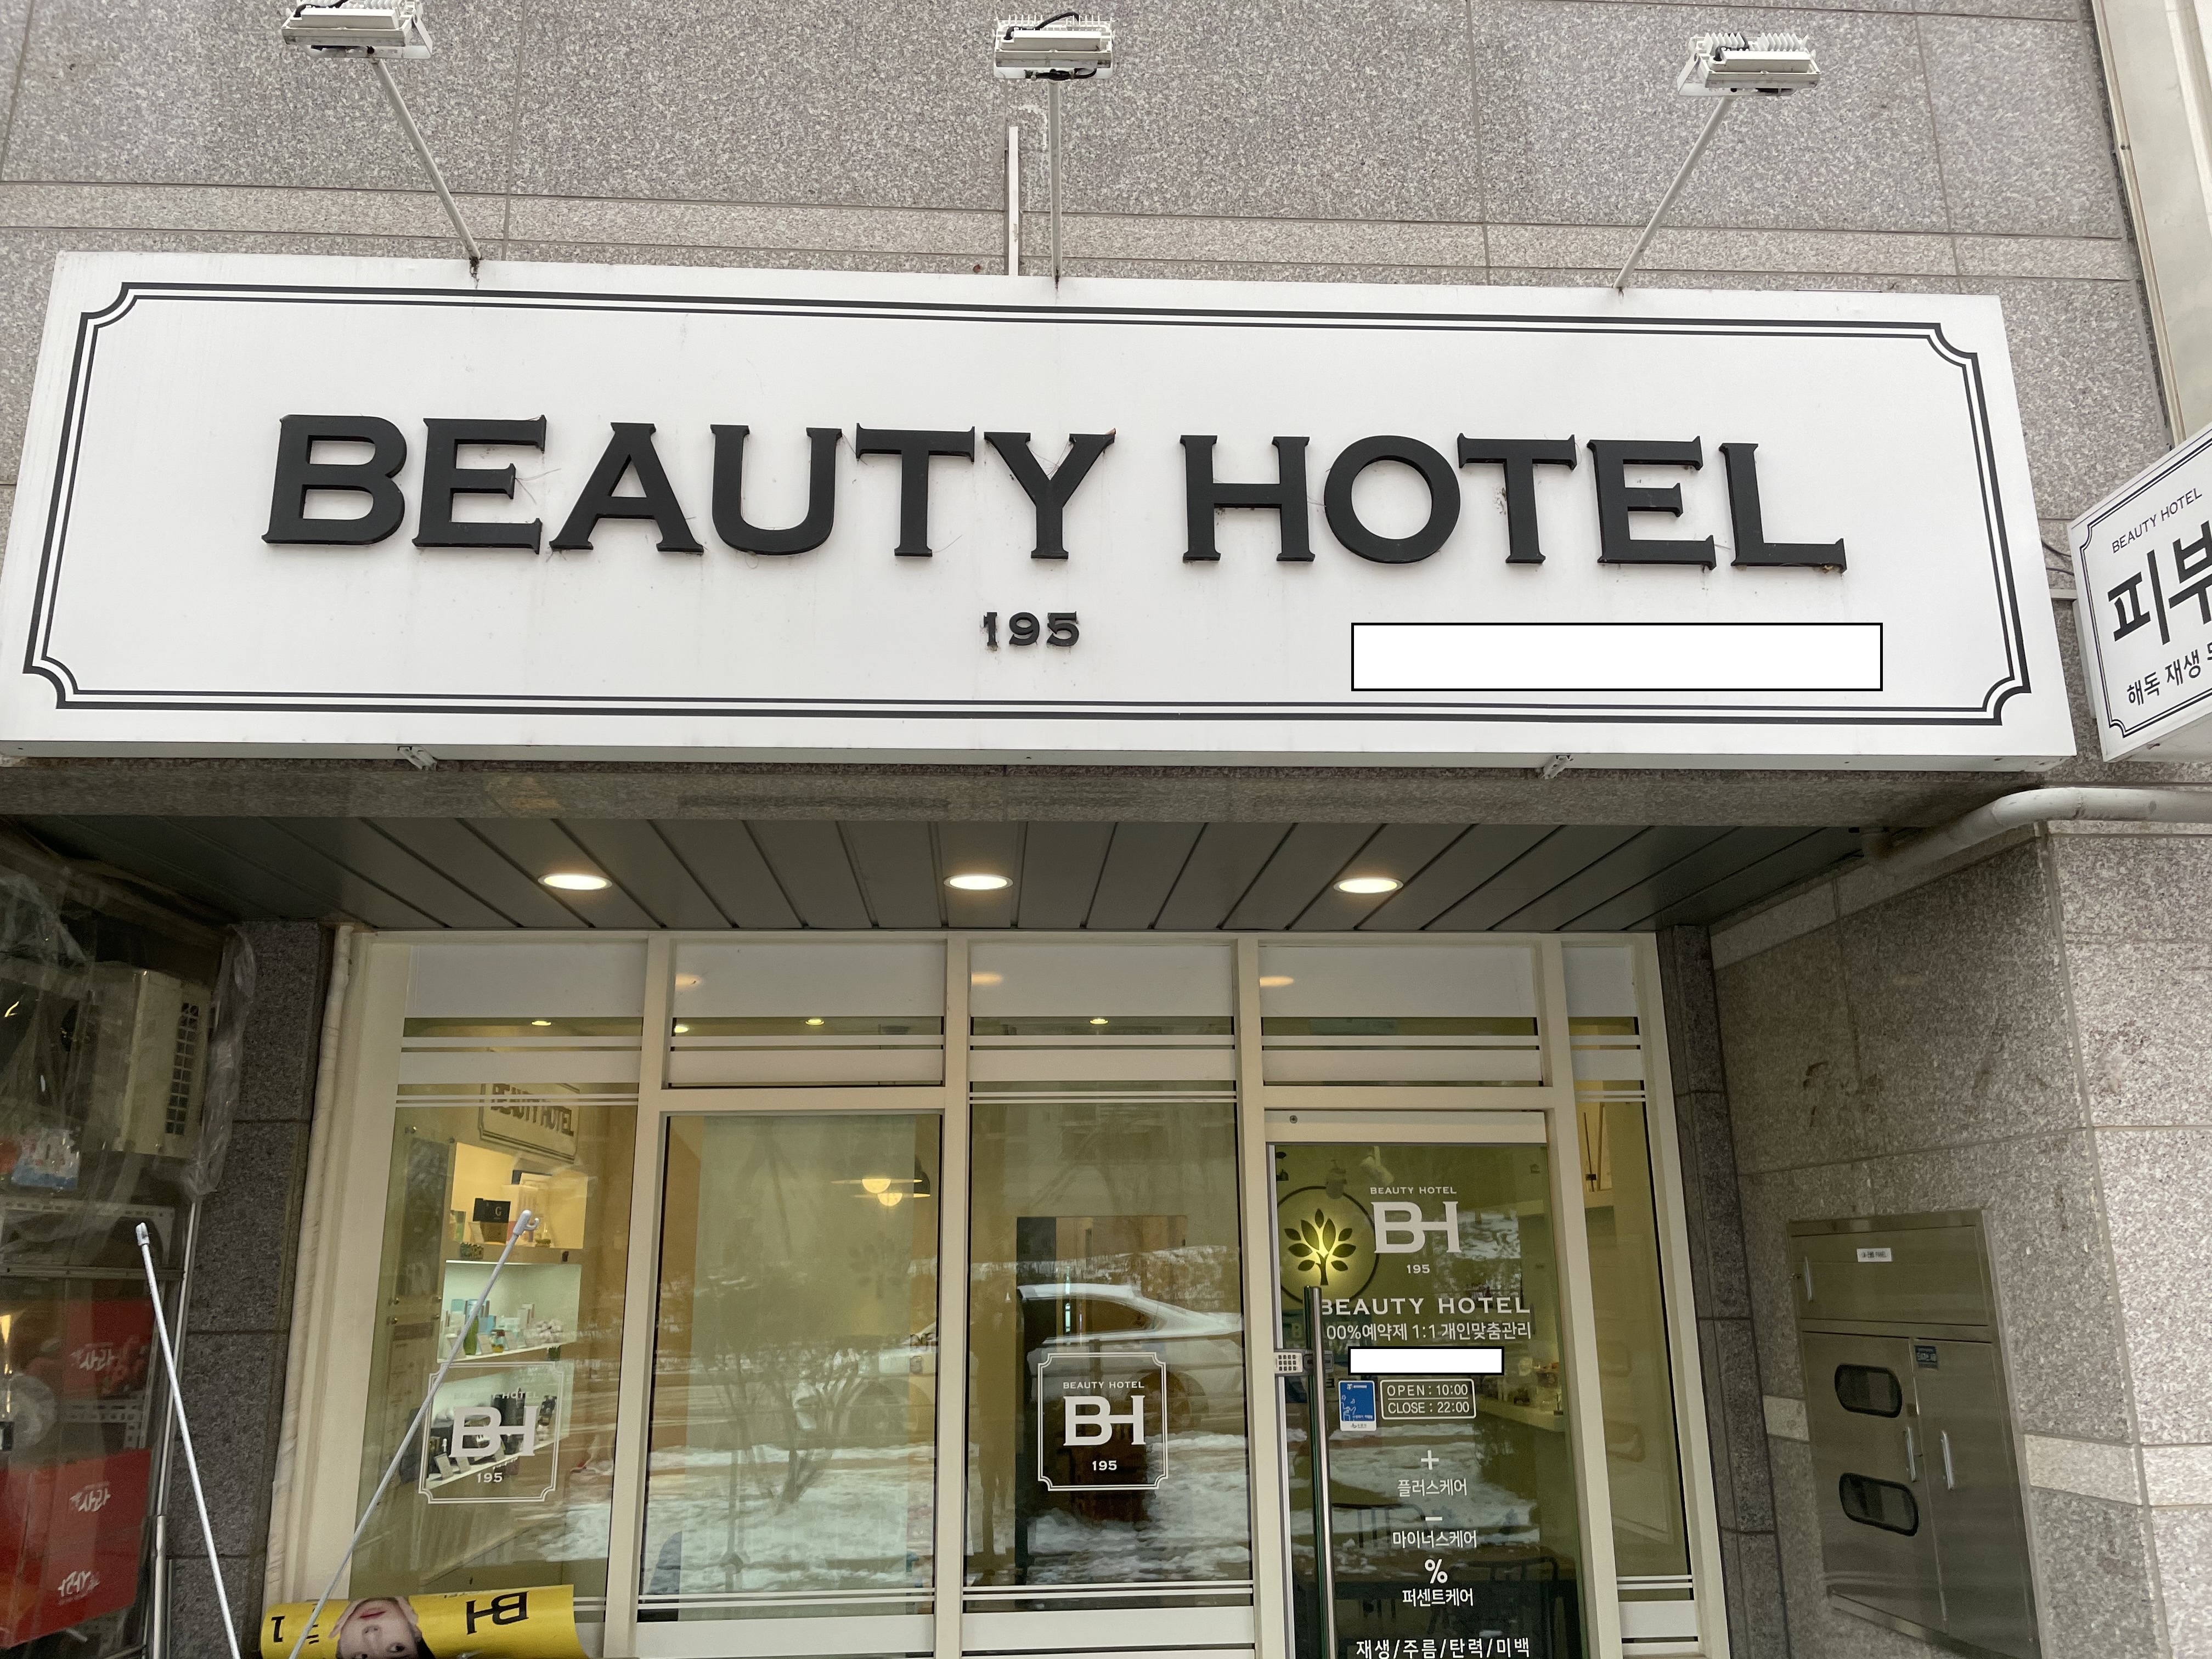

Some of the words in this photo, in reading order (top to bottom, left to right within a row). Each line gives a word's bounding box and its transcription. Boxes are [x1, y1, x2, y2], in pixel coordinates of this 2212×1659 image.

[262, 414, 1116, 560] BEAUTY
[1180, 433, 1847, 574] HOTEL
[2112, 514, 2157, 554] BEAUTY
[2160, 488, 2203, 522] HOTEL
[984, 611, 1079, 649] 195
[2127, 671, 2160, 706] 해독
[2165, 649, 2201, 686] 재생
[1371, 1201, 1462, 1253] BH
[1407, 1264, 1430, 1274] 195
[1322, 1298, 1424, 1316] BEAUTY
[1438, 1296, 1531, 1314] HOTEL
[1326, 1323, 1407, 1341] 00%예약제
[1441, 1322, 1531, 1340] 개인맞춤관리
[1436, 1384, 1469, 1396] 10:00
[1437, 1402, 1470, 1413] 22:00
[1063, 1395, 1146, 1446] BH
[449, 1406, 539, 1458] BH
[1092, 1460, 1118, 1471] 195
[477, 1472, 503, 1483] 195
[1397, 1479, 1467, 1497] 플러스케어
[1392, 1530, 1477, 1549] 마이너스케어
[1402, 1588, 1474, 1607] 퍼센트케어
